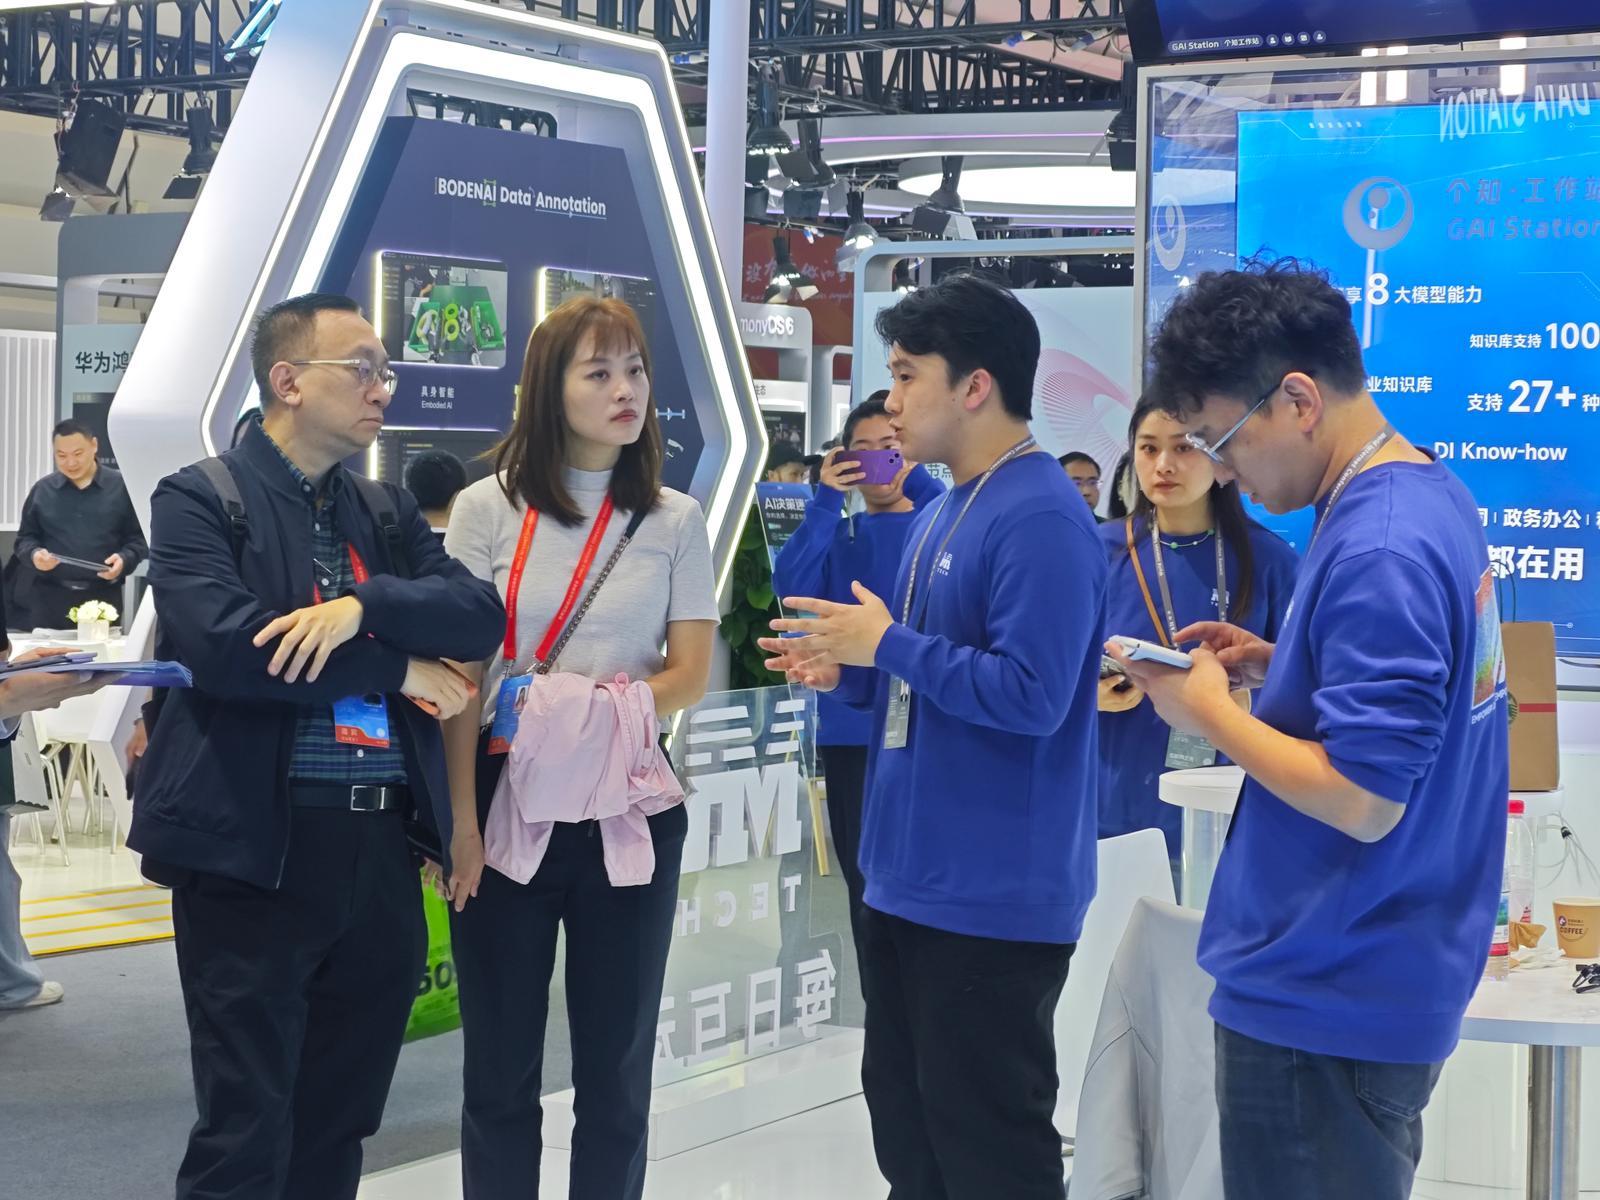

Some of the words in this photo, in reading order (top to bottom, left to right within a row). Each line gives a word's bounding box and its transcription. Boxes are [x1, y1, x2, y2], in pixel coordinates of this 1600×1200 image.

[1172, 42, 1186, 51] GAI
[1188, 40, 1219, 50] Station
[438, 177, 497, 202] BODENAI
[500, 186, 532, 206] Data
[535, 191, 607, 216] Annotation
[1339, 286, 1362, 304] 享
[1367, 273, 1389, 305] 8
[1394, 285, 1482, 304] 大模型能力
[1470, 333, 1542, 348] 知识库支持
[1467, 393, 1503, 412] 支持
[1508, 379, 1576, 413] 27+
[1461, 441, 1568, 461] Know-how
[1503, 507, 1582, 530] 政务办公
[1560, 926, 1584, 935] COFFEE
